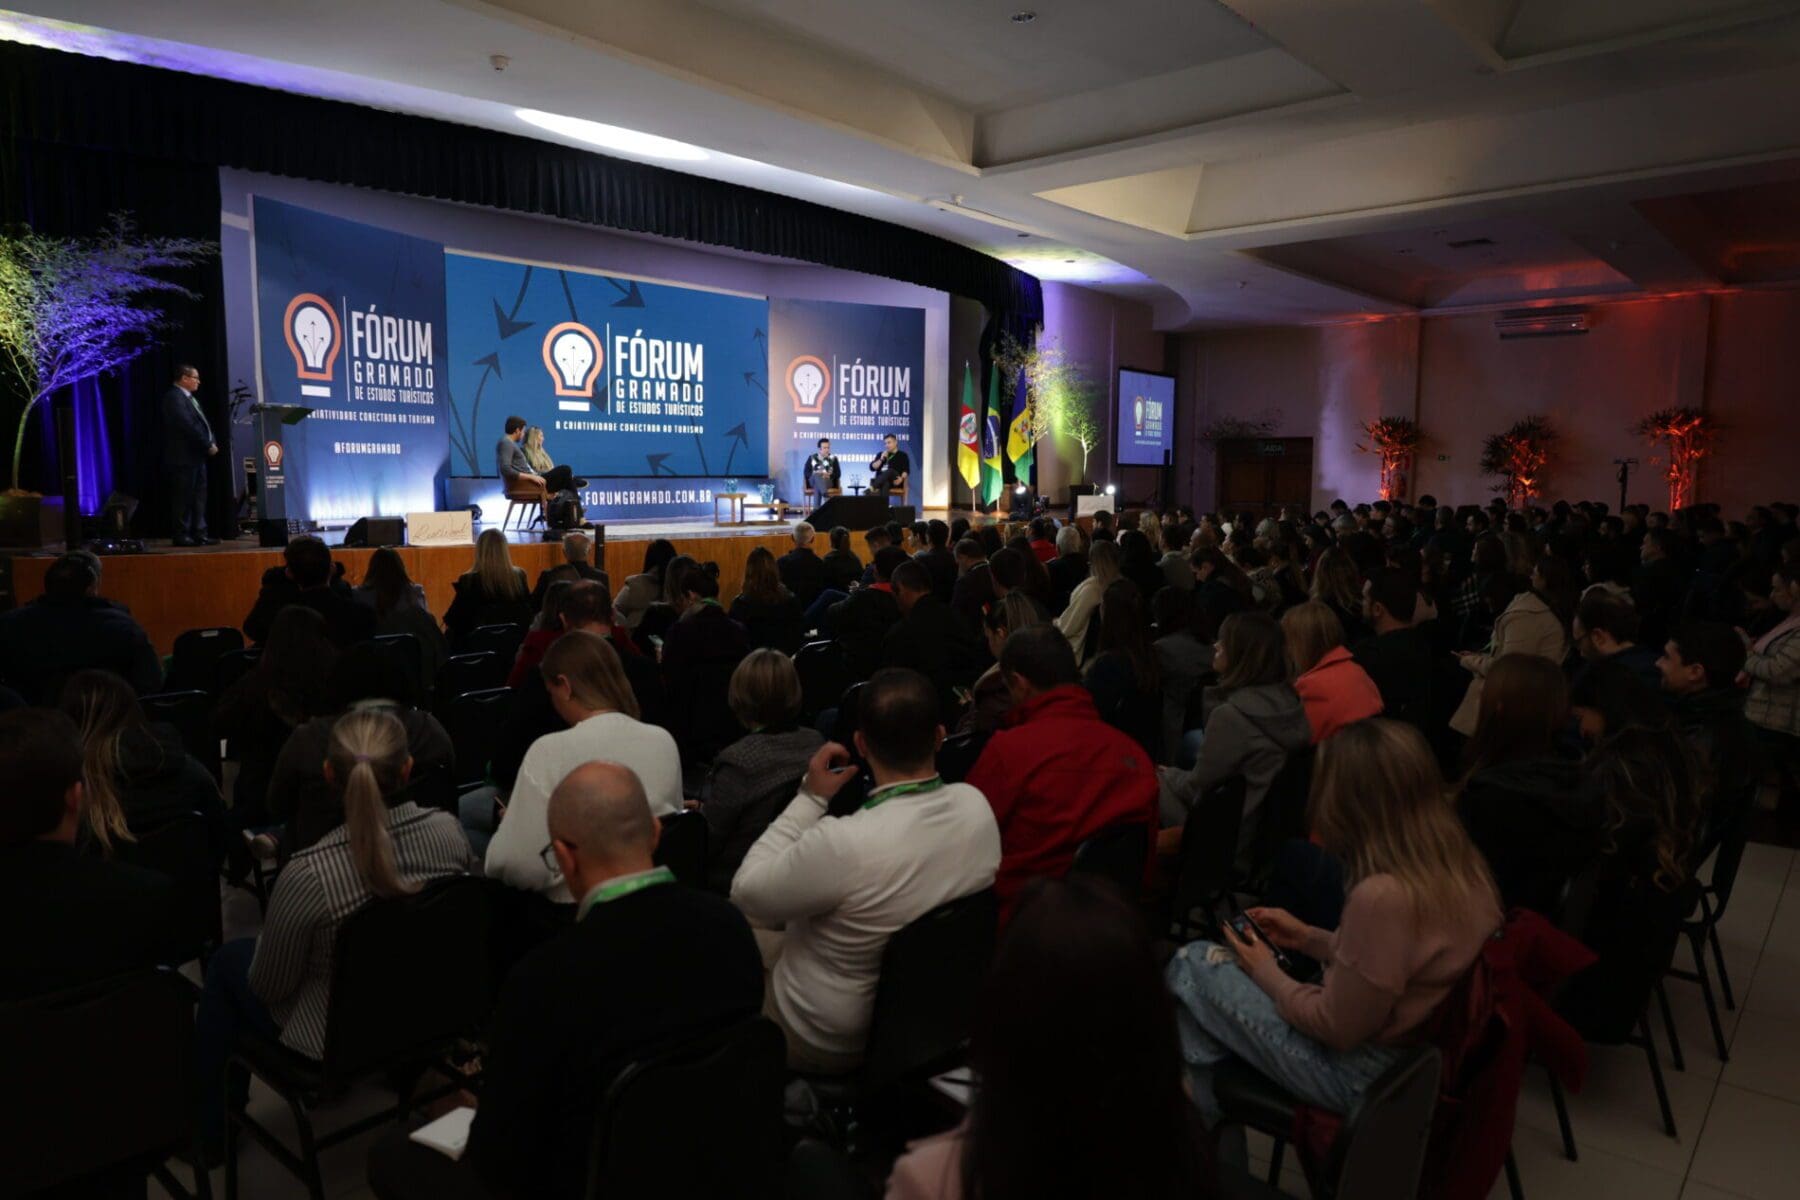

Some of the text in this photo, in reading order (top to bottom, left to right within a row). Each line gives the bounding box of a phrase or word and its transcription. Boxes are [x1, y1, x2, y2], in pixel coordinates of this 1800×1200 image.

[351, 304, 433, 366] FÓRUM
[615, 329, 704, 382] FÓRUM
[354, 360, 434, 389] GRAMADO
[839, 358, 911, 398] FÓRUM
[355, 386, 434, 404] DE ESTUDOS TURÍSTICOS
[616, 378, 704, 403] GRAMADO
[616, 400, 704, 417] DE ESTUDOS TURÍSTICOS
[839, 398, 910, 415] GRAMADO
[359, 411, 396, 423] CONECTADA
[399, 414, 407, 424] AO
[408, 414, 435, 424] TURISMO
[839, 415, 910, 427] DE ESTUDOS TURÍSTICOS
[555, 420, 704, 434] A CRIATIVIDADE CONECTADA AO TURISMO
[841, 432, 874, 440] CONECTADA
[334, 441, 401, 455] @FORUMGRAMADO
[577, 489, 712, 506] .FORUMGRAMADO.COM.BR
